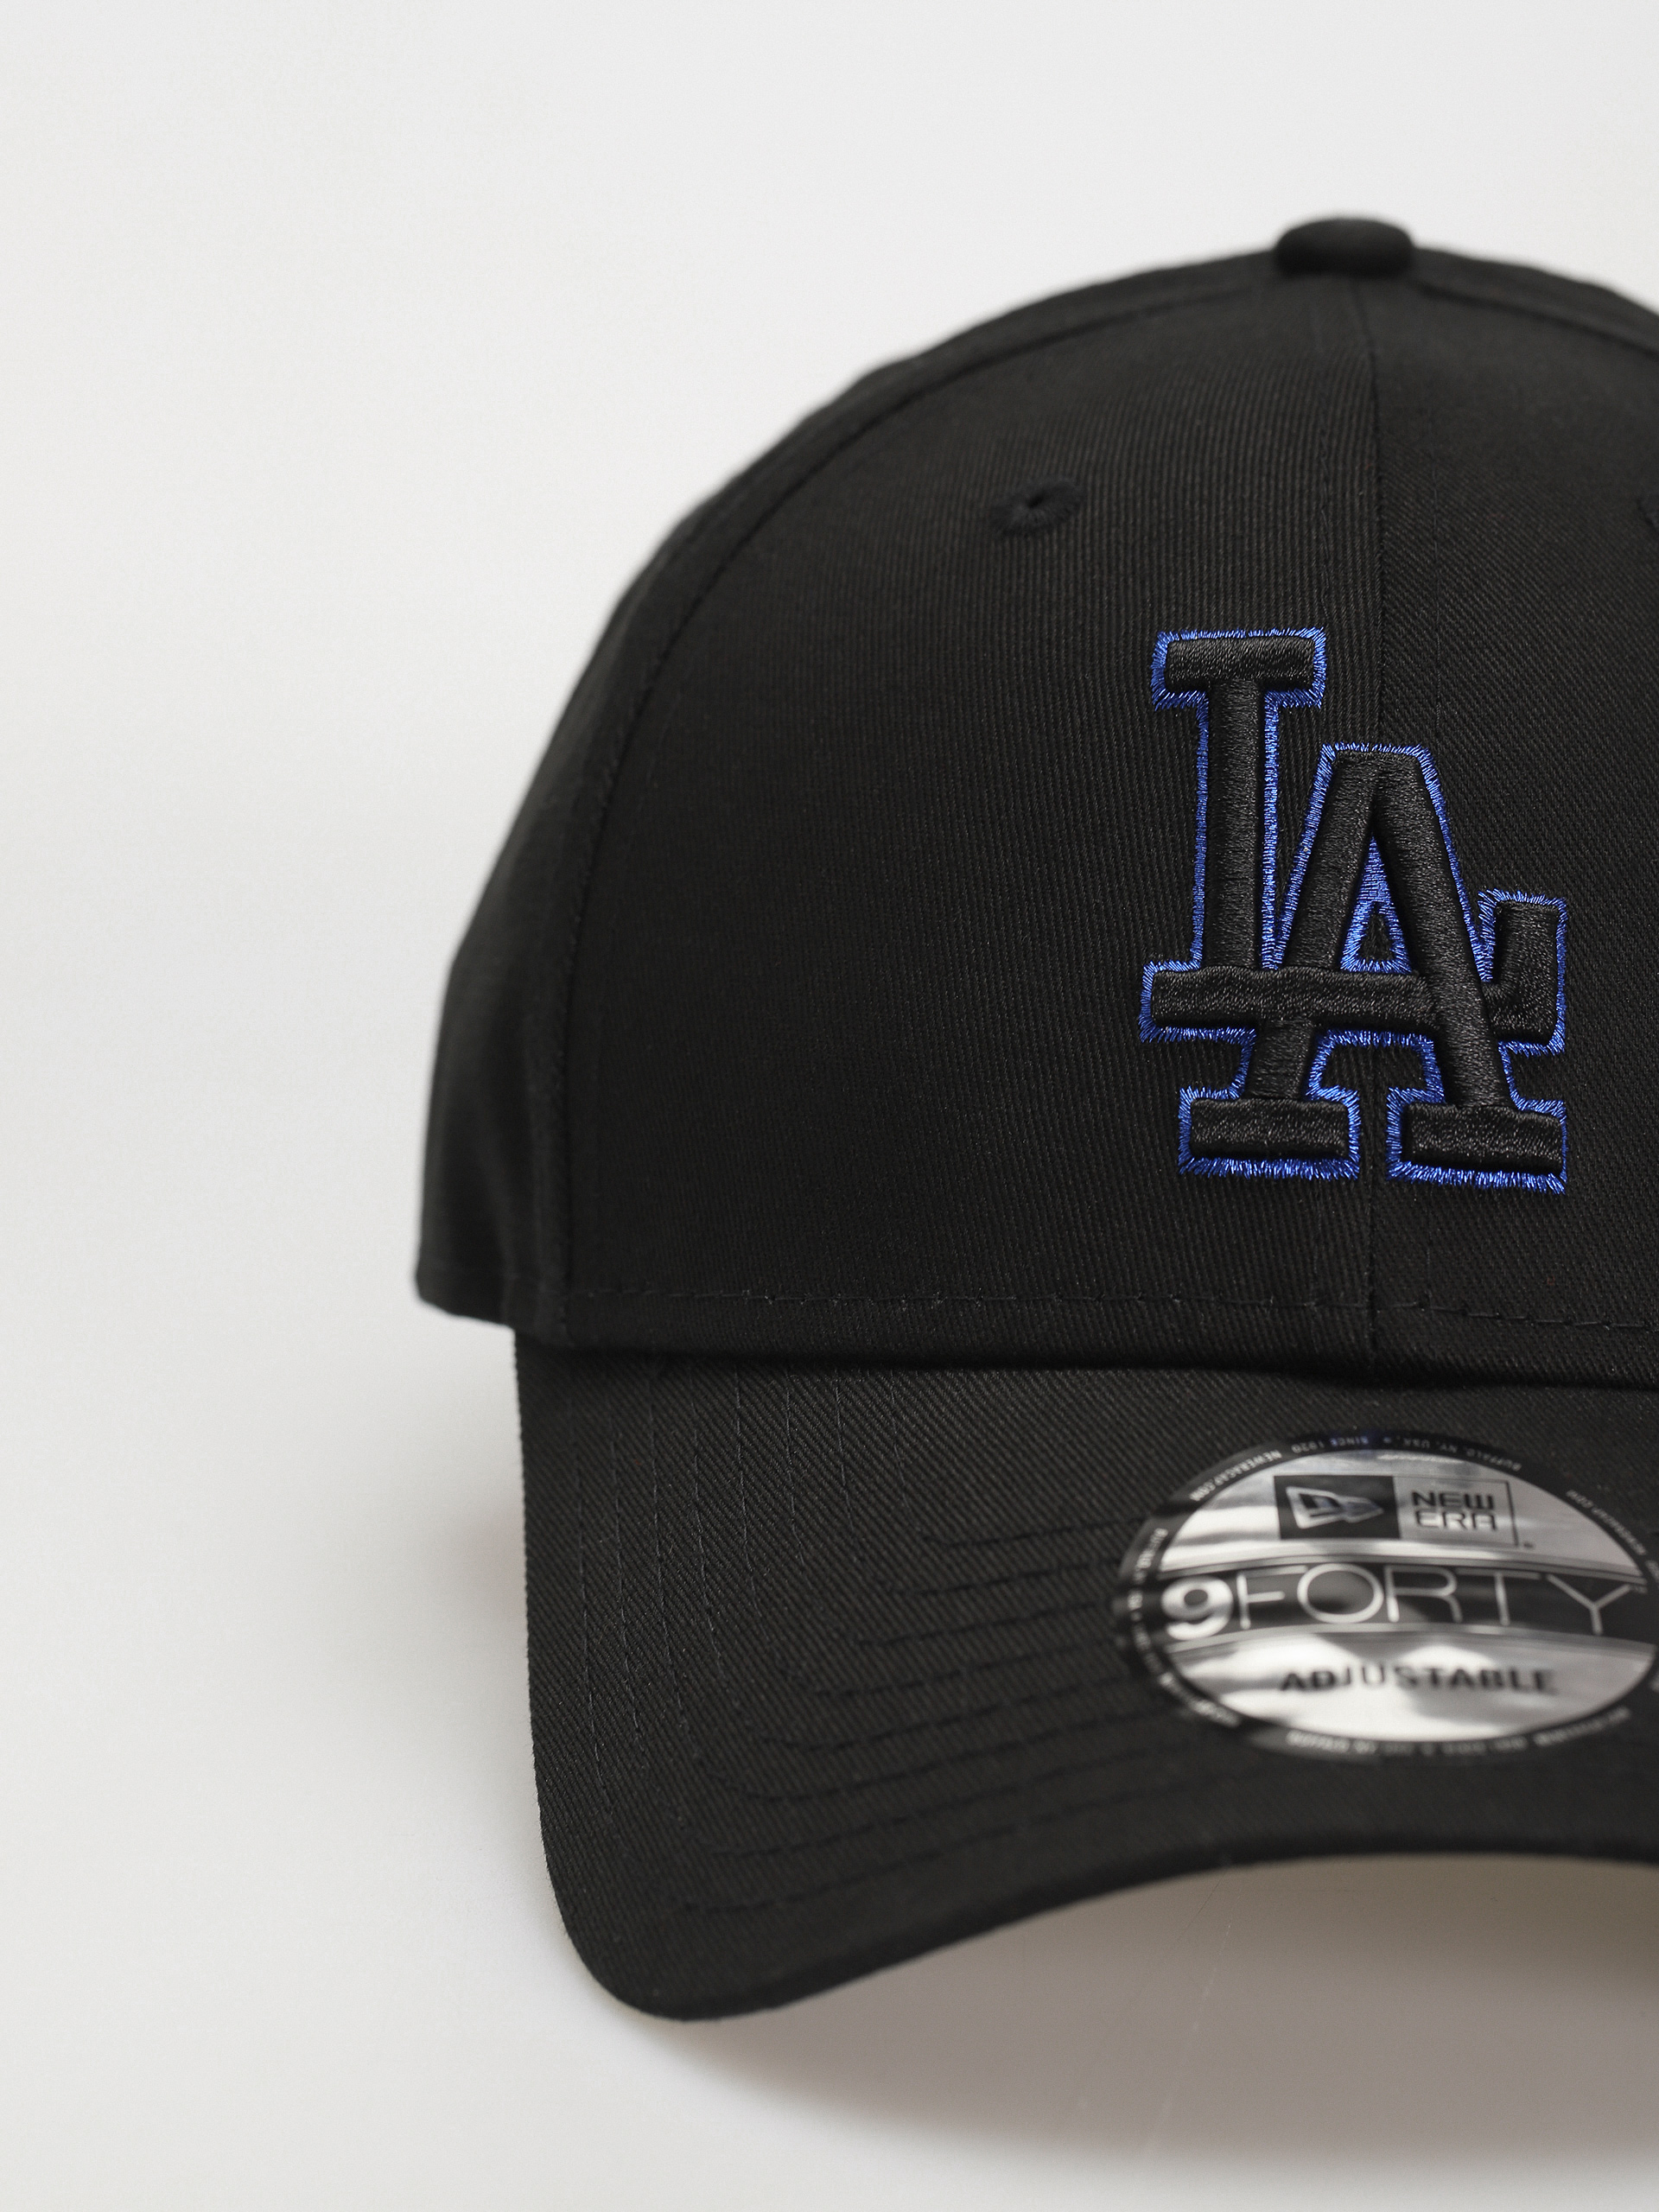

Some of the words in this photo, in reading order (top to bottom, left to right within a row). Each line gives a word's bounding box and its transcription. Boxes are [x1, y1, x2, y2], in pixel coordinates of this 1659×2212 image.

[1138, 627, 1568, 1196] LA
[1410, 1490, 1496, 1511] NEW
[1413, 1510, 1498, 1532] ERA
[1160, 1561, 1634, 1641] 9FORTY
[1279, 1662, 1554, 1694] ADJUSTABLE
